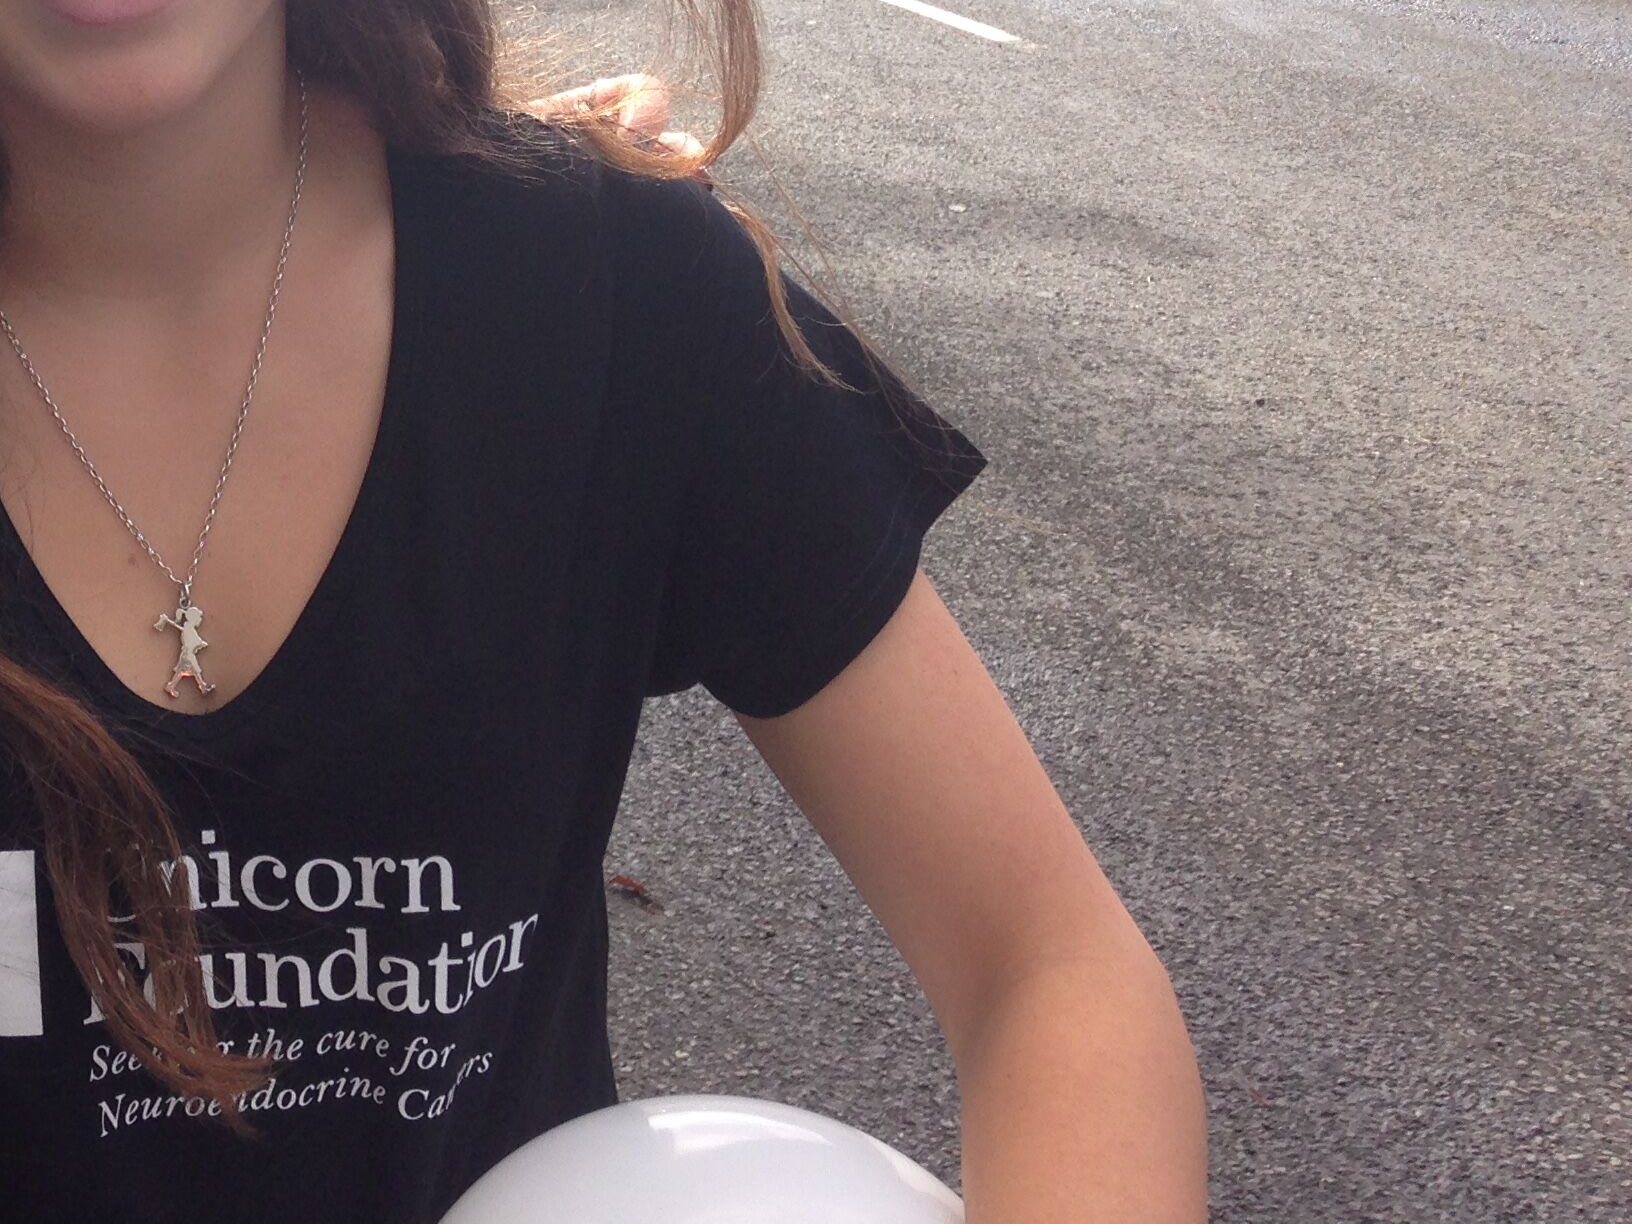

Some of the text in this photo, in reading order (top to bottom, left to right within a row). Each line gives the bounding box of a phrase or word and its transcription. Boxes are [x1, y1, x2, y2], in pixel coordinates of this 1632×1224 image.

[106, 829, 462, 922] nicorn
[247, 1028, 304, 1060] the
[316, 1030, 390, 1058] cure
[389, 1037, 457, 1076] for
